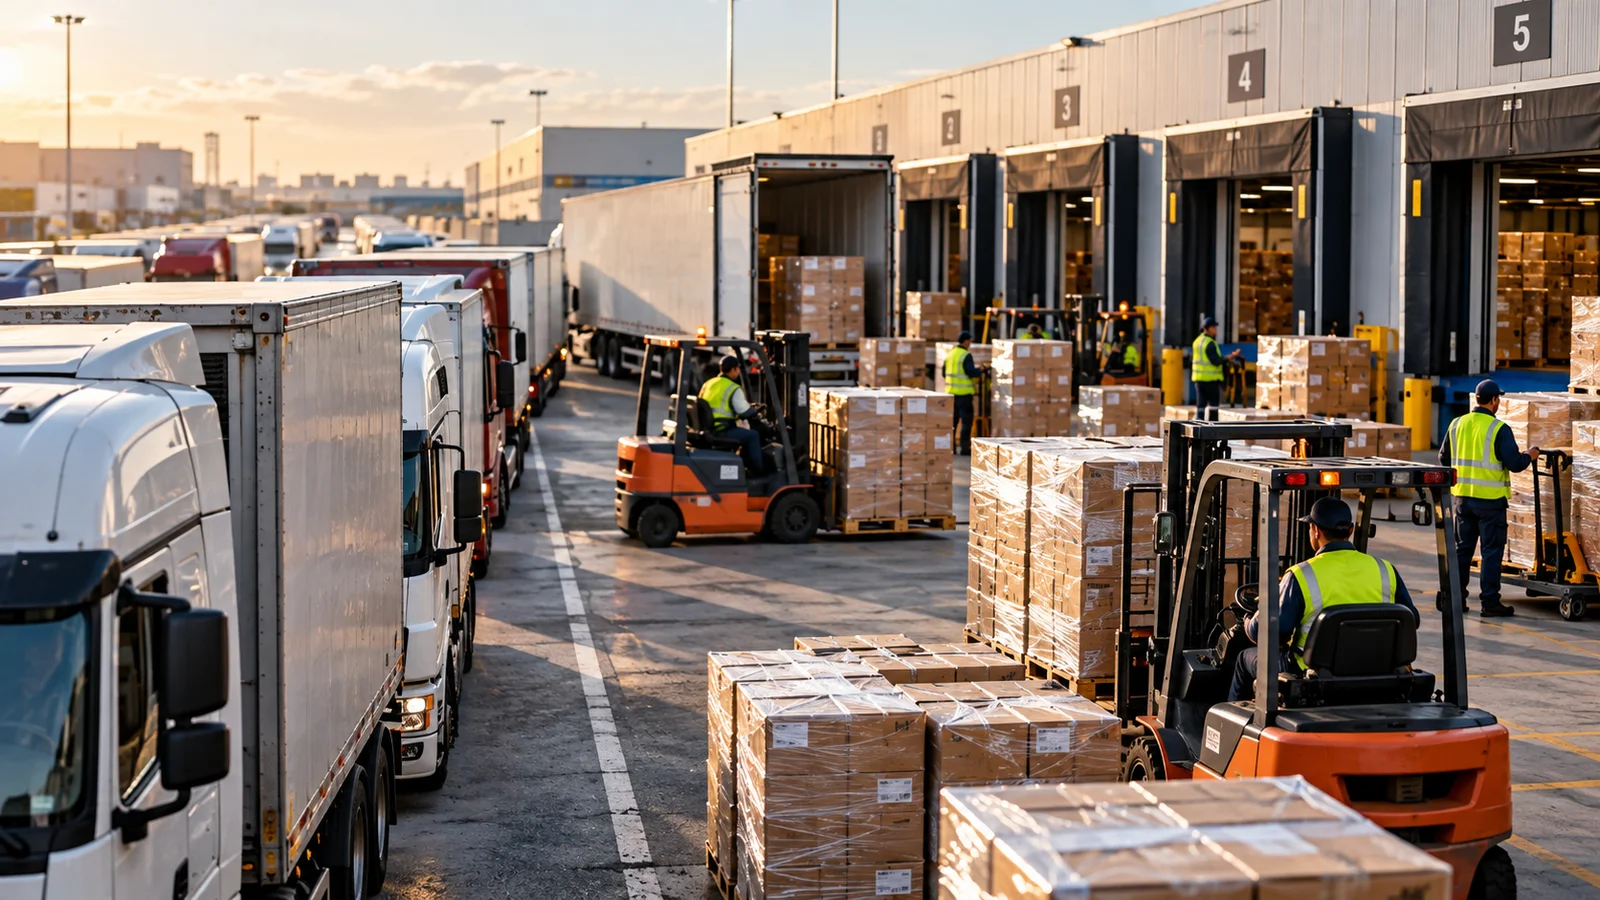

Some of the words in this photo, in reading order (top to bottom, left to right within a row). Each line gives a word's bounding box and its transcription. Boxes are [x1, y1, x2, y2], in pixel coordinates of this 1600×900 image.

[1512, 13, 1530, 52] 5
[1238, 60, 1252, 92] 4
[1062, 94, 1071, 121] 3
